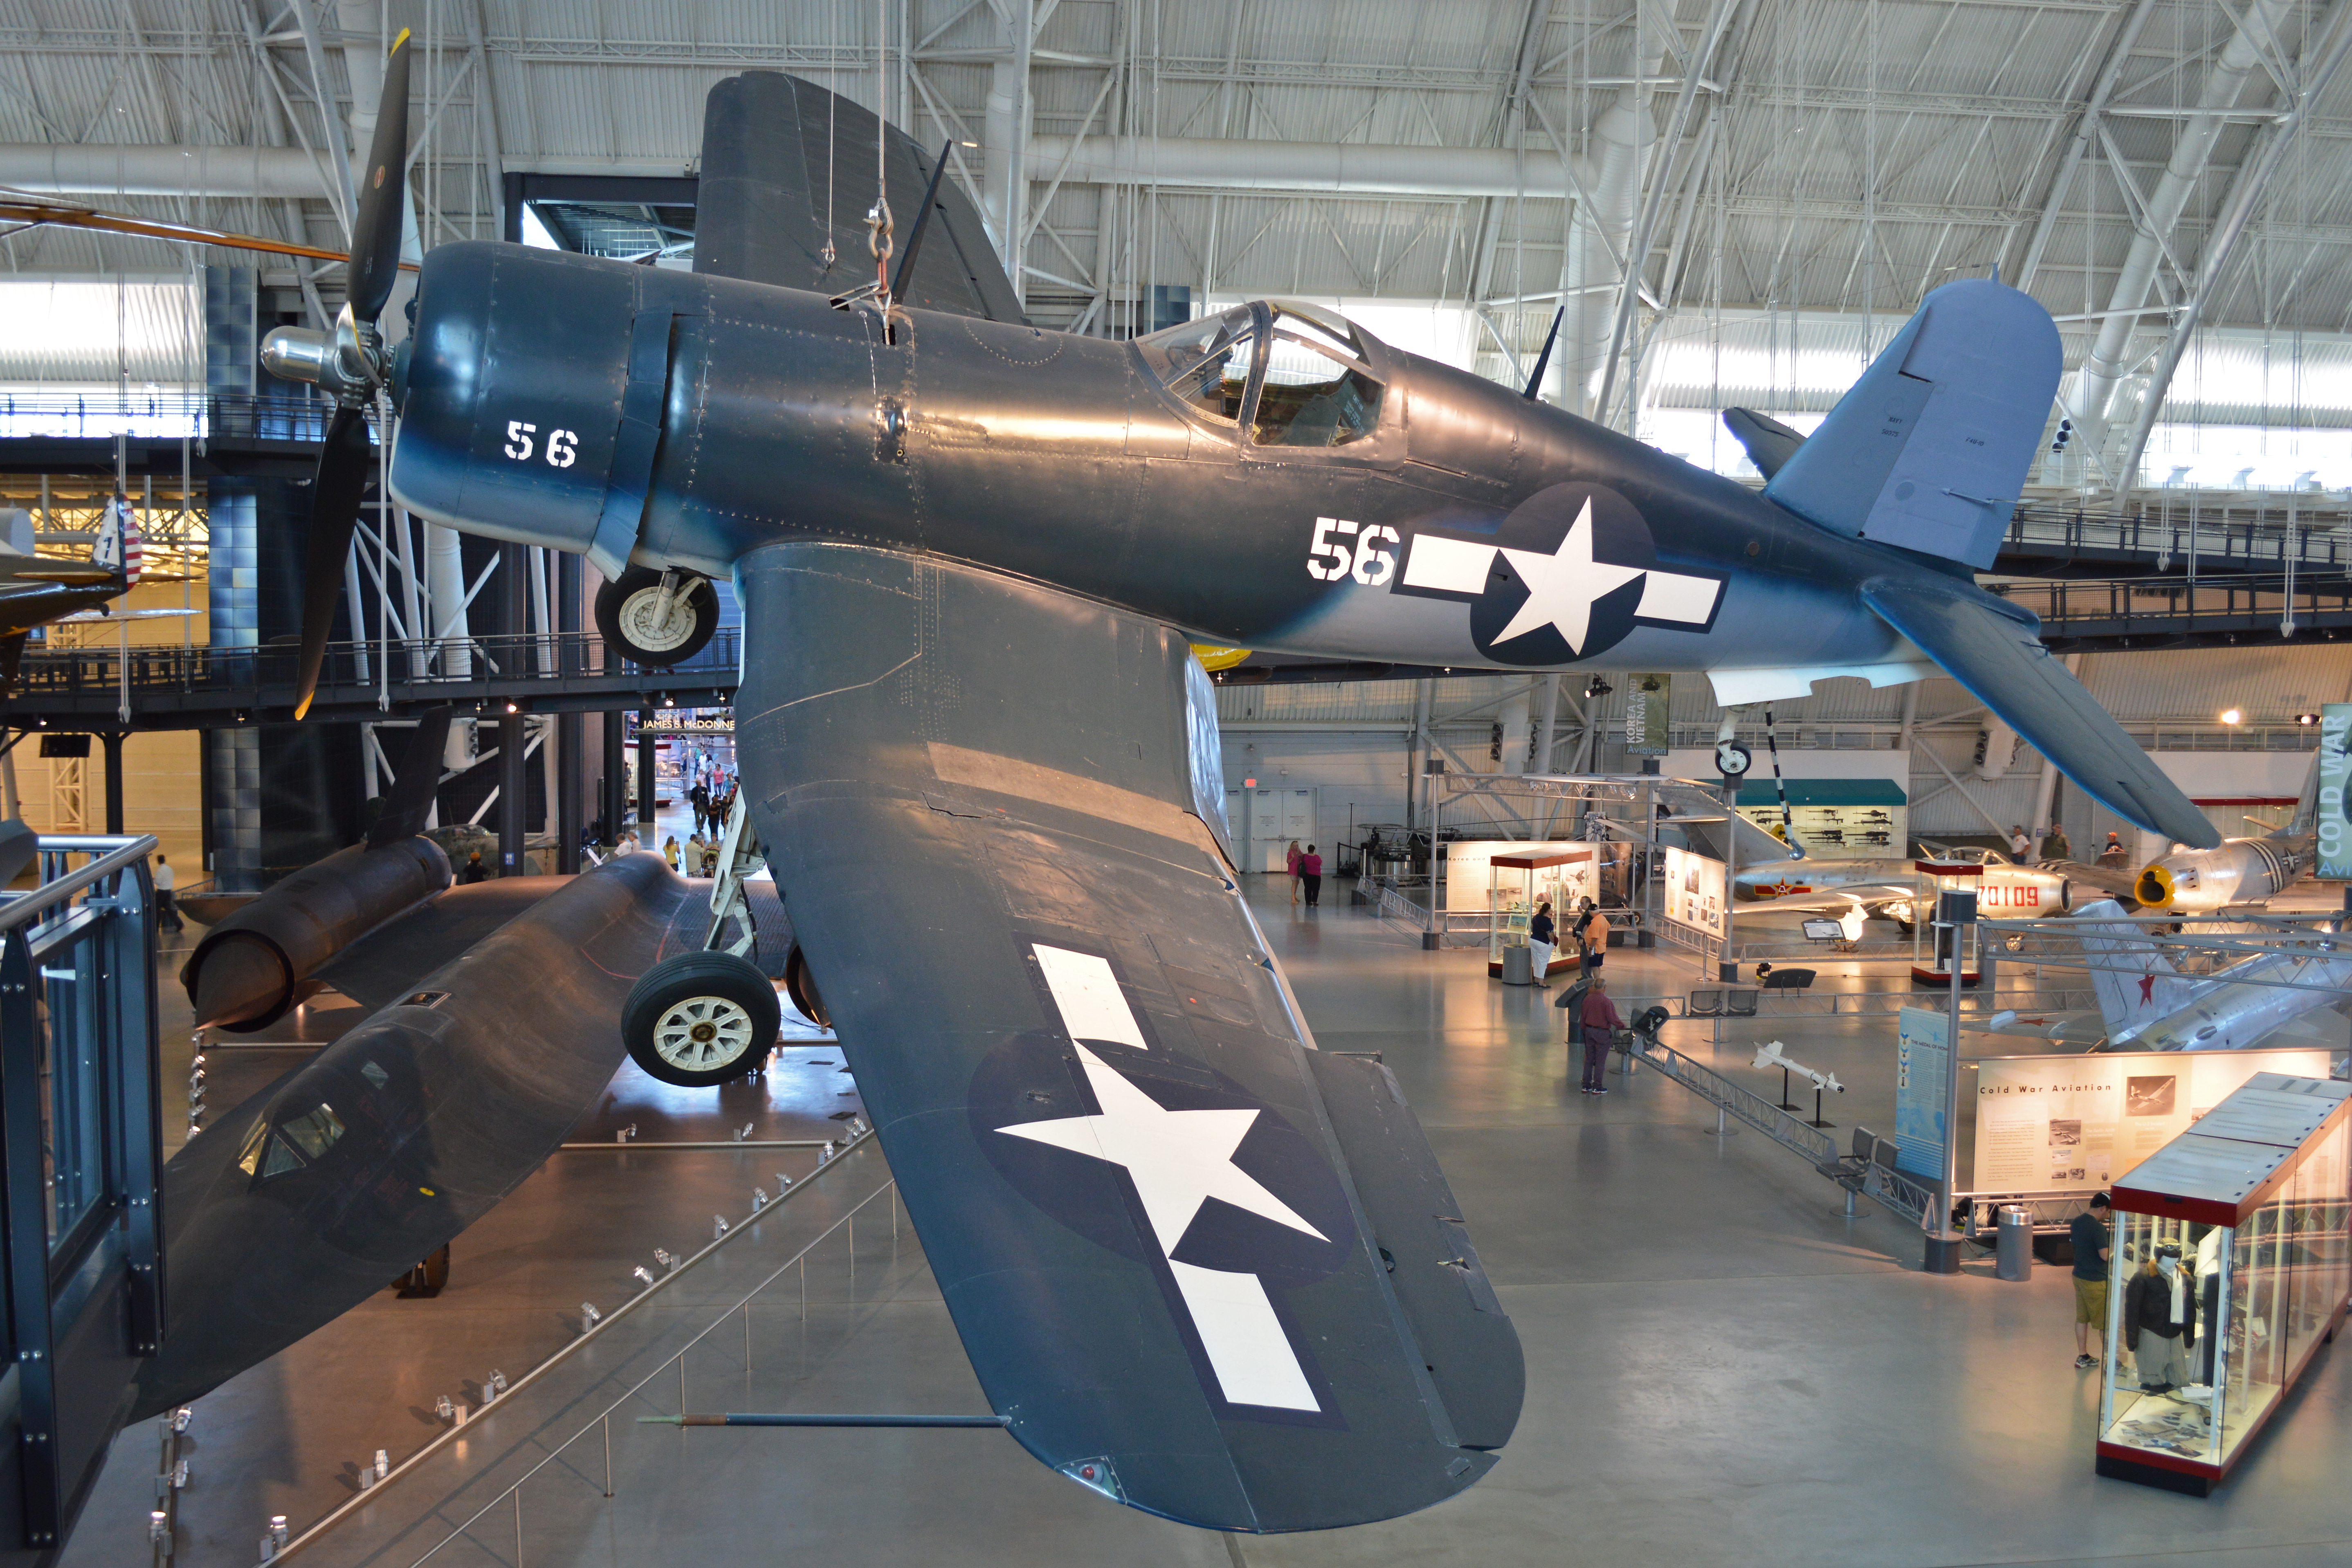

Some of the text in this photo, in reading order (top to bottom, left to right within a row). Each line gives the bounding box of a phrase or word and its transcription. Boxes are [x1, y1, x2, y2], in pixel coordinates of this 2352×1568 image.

[505, 421, 578, 468] 56
[1307, 517, 1400, 586] 56
[643, 720, 672, 729] JAMES
[675, 720, 682, 728] S.
[1626, 679, 1637, 744] KOREA AND
[1636, 692, 1646, 744] VIETNAM
[1627, 745, 1666, 755] Aviation
[2318, 714, 2345, 857] COLD WAR
[1976, 885, 2038, 907] 70109
[1980, 1086, 2009, 1094] Cold
[2052, 1084, 2111, 1092] Aviation
